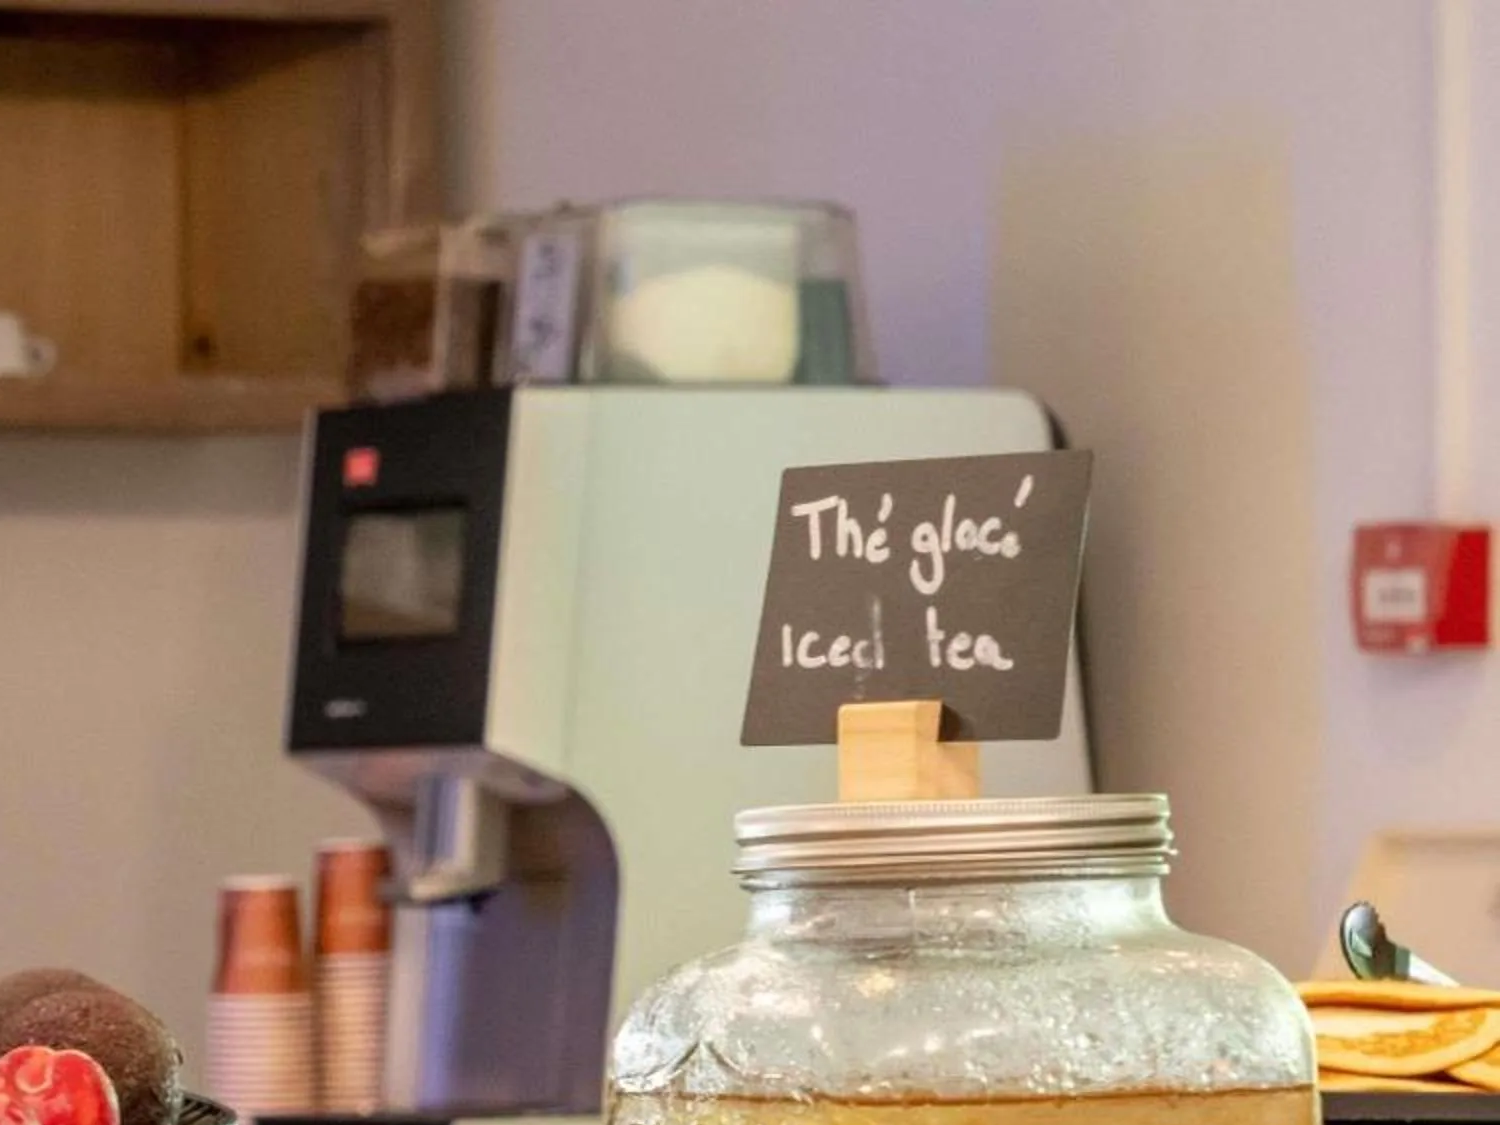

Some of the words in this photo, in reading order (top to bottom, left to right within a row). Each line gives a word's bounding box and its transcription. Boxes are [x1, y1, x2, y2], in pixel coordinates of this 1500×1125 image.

[791, 492, 893, 563] Thé
[780, 598, 885, 670] Iced
[926, 605, 1015, 671] tea
